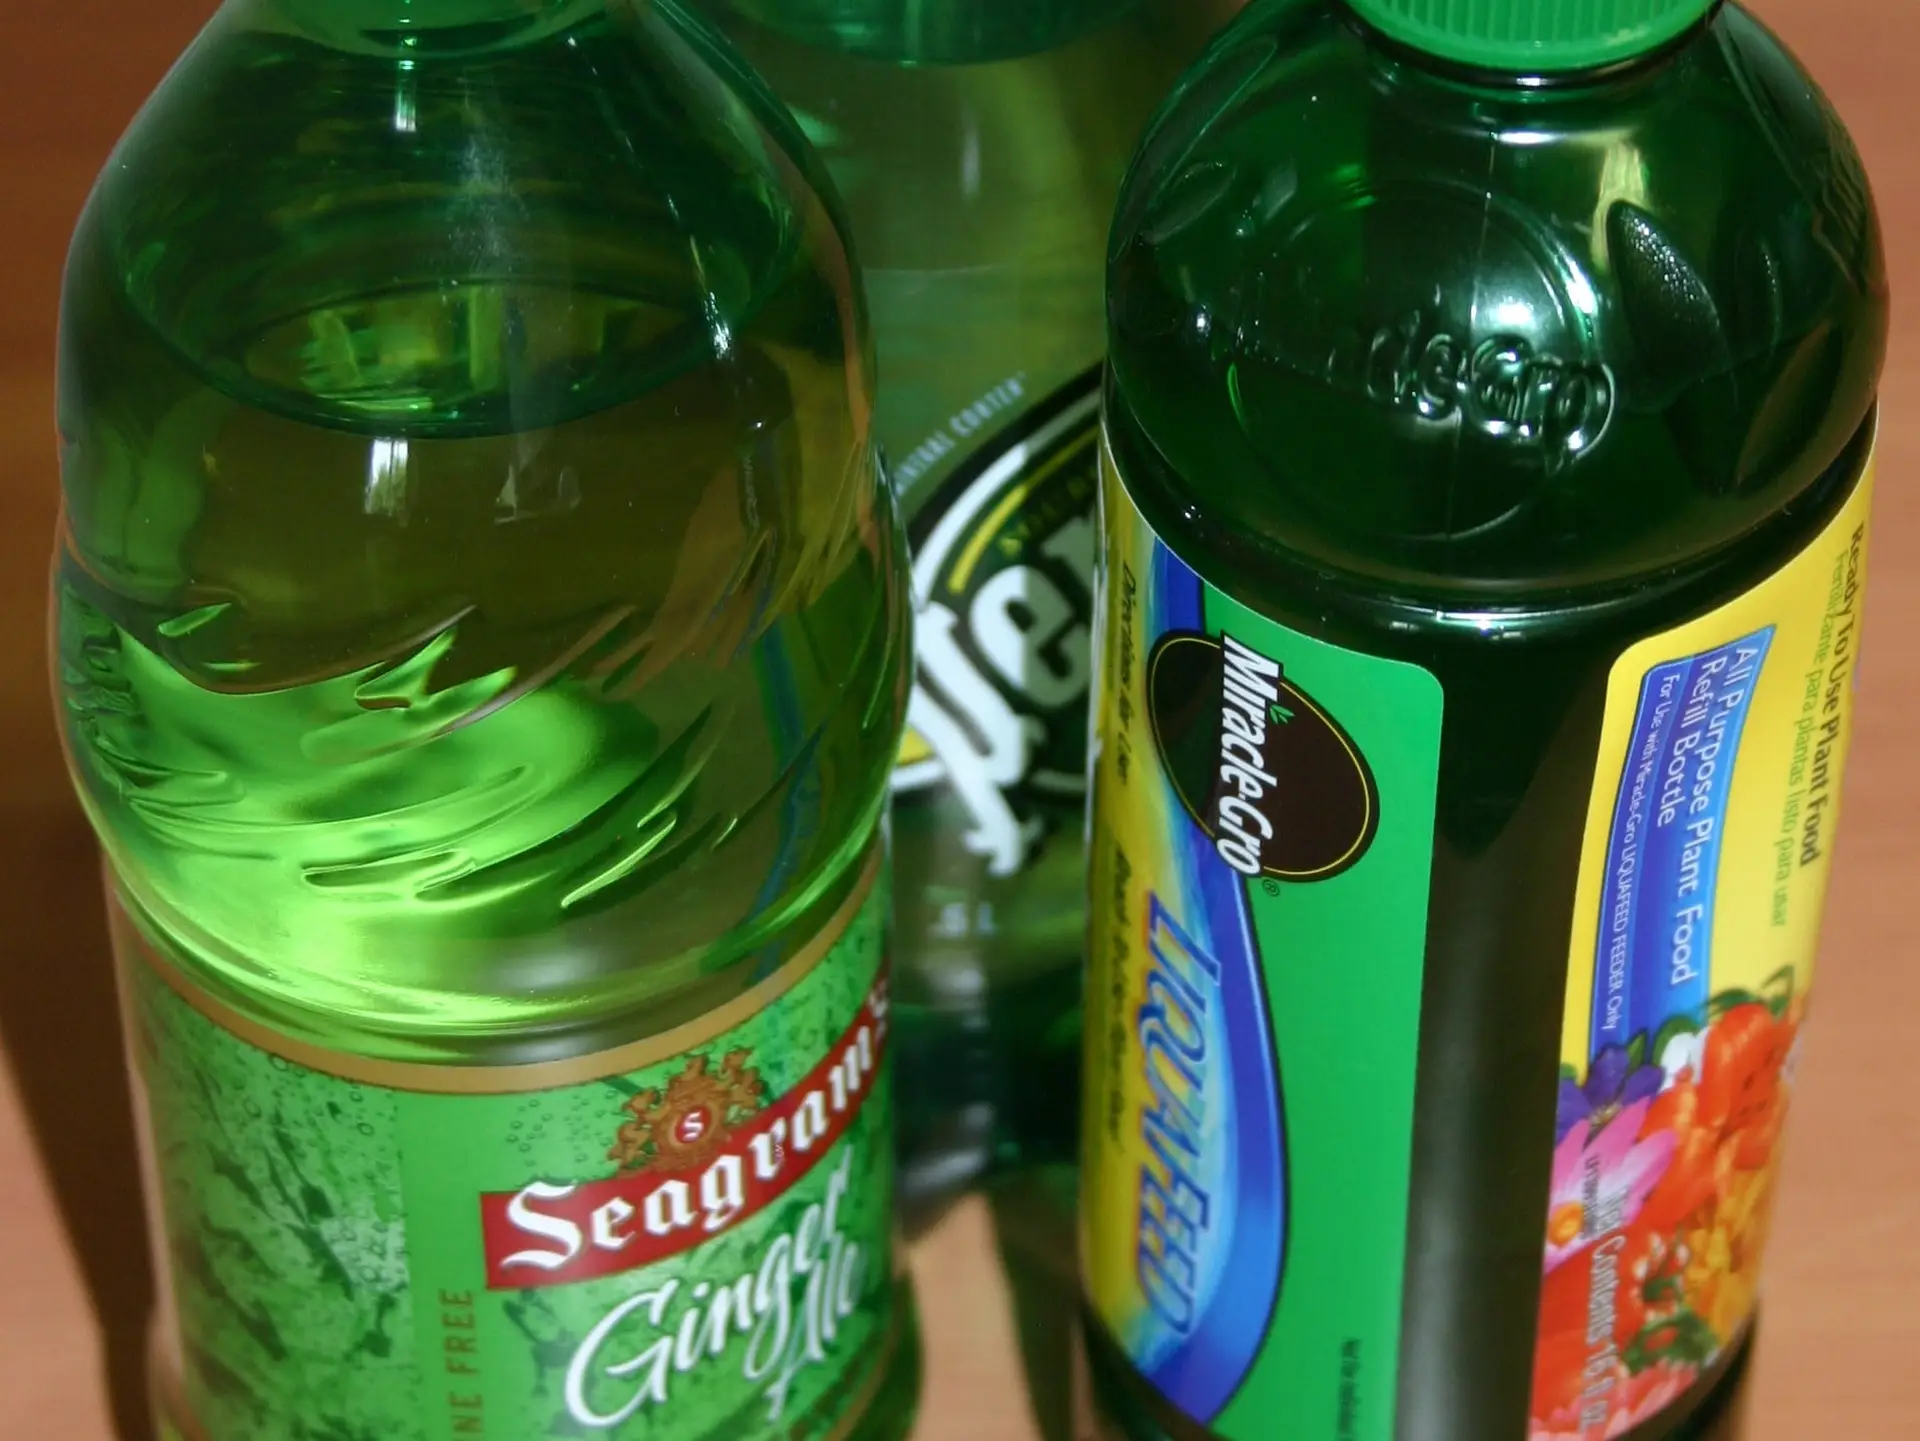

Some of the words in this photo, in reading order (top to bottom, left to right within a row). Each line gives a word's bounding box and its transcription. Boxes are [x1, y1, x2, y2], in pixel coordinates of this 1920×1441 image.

[1812, 549, 1848, 666] Fertilizante
[1834, 520, 1864, 617] Ready
[1721, 647, 1759, 686] All
[1833, 614, 1855, 657] To
[1648, 699, 1672, 730] Use
[1657, 673, 1680, 698] For
[1678, 655, 1728, 729] Refill
[1804, 669, 1824, 713] para
[1821, 656, 1850, 716] Use
[1214, 636, 1278, 874] Miracle-Gro
[1637, 729, 1659, 760] with
[1655, 731, 1701, 827] Bottle
[1687, 688, 1744, 815] Purpose
[1787, 716, 1817, 787] plantas
[1807, 714, 1841, 795] Plant
[1622, 759, 1653, 844] Miracle-Gro
[1779, 788, 1807, 834] listo
[1798, 793, 1829, 868] Food
[1611, 844, 1637, 932] LIQUAFEED
[1676, 816, 1714, 898] Plant
[1772, 836, 1796, 884] para
[1605, 934, 1627, 994] FEEDER
[1669, 903, 1704, 985] Food
[1599, 995, 1622, 1031] Only
[682, 1111, 703, 1141] S
[1135, 891, 1221, 1337] LIQUAFEED
[565, 1145, 854, 1427] Ginger
[1586, 1235, 1625, 1346] Contents
[438, 1288, 482, 1375] FREE
[768, 1232, 866, 1423] Ale
